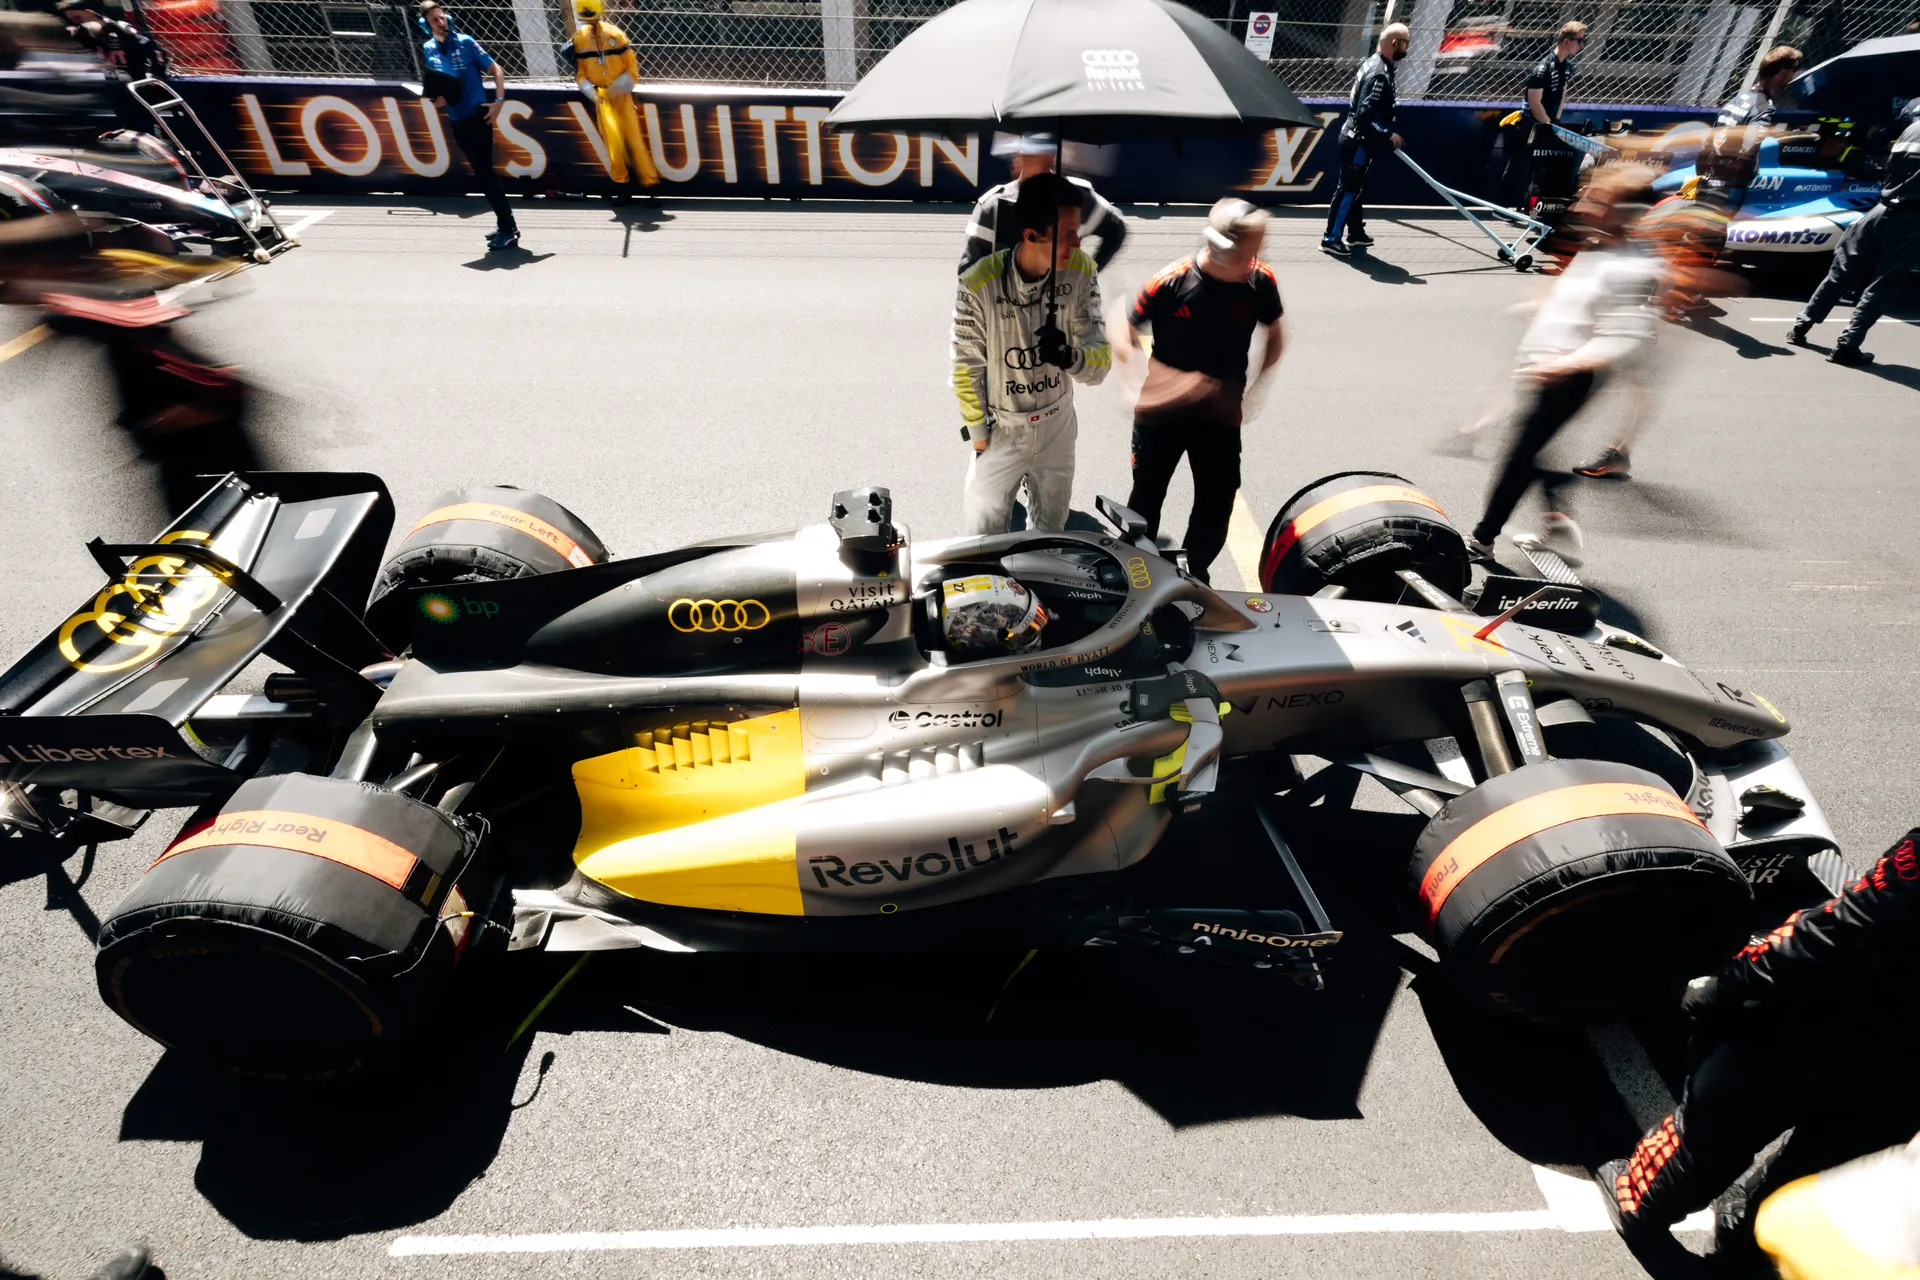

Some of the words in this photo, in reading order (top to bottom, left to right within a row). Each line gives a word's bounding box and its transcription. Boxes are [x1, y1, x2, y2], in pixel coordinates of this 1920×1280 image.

[242, 94, 547, 179] LOUS
[1849, 183, 1880, 193] Claude
[1728, 228, 1832, 245] KOMATSU
[1044, 406, 1060, 417] YEN
[489, 509, 527, 528] Rear
[528, 521, 560, 545] Left
[848, 581, 896, 598] visit
[462, 597, 500, 618] bp
[829, 596, 896, 612] QATAR
[1020, 660, 1056, 673] WORLD
[1060, 656, 1074, 667] OF
[1077, 645, 1110, 664] HYATT
[1206, 639, 1219, 664] NEXO
[1266, 690, 1345, 711] NEXO
[914, 709, 1003, 728] Castrol
[1516, 712, 1541, 756] Extreme
[7, 744, 177, 764] Libertex
[206, 817, 266, 838] Right
[268, 821, 327, 844] Rear
[808, 826, 1020, 888] Revolut
[1428, 856, 1459, 898] Front
[1192, 921, 1329, 948] ninjaOne
